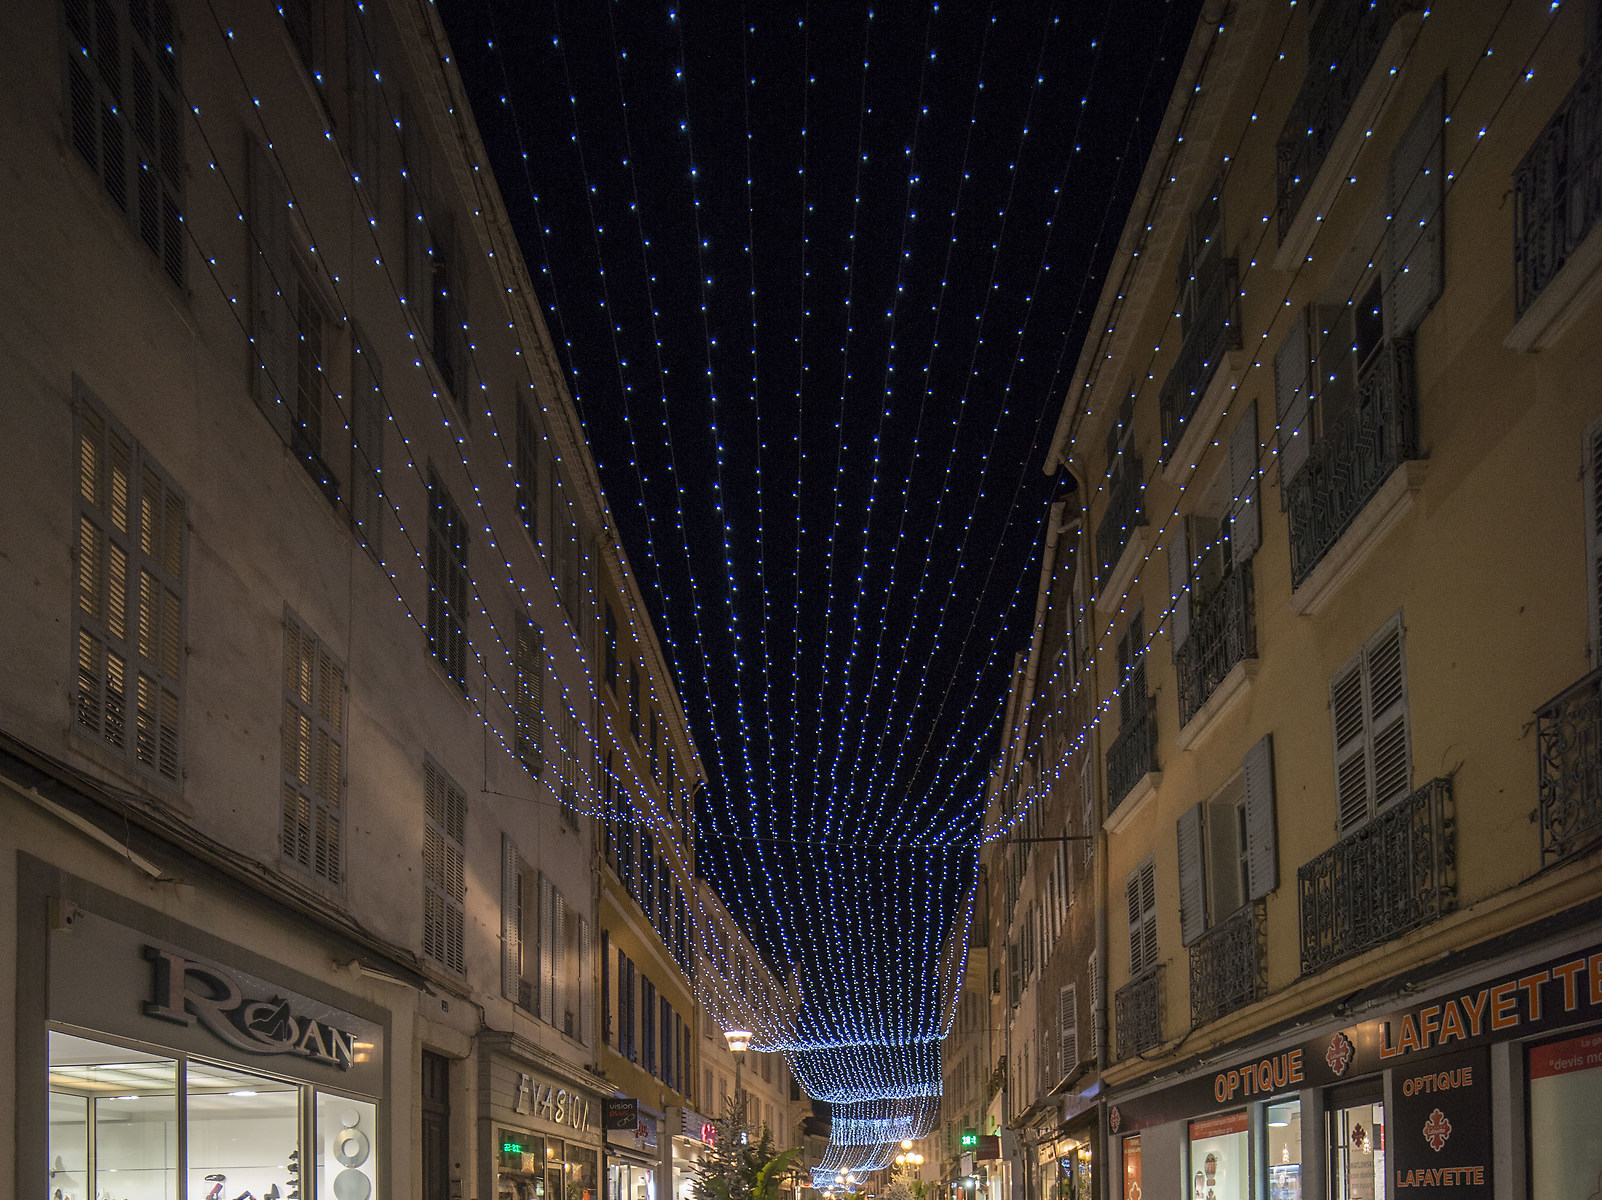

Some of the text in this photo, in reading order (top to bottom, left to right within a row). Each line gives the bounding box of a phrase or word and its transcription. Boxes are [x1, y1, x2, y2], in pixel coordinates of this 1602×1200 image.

[1214, 1049, 1303, 1103] OPTIQUE
[1403, 1067, 1473, 1097] OPTIQUE
[1397, 1166, 1484, 1187] LAFAYETTE
